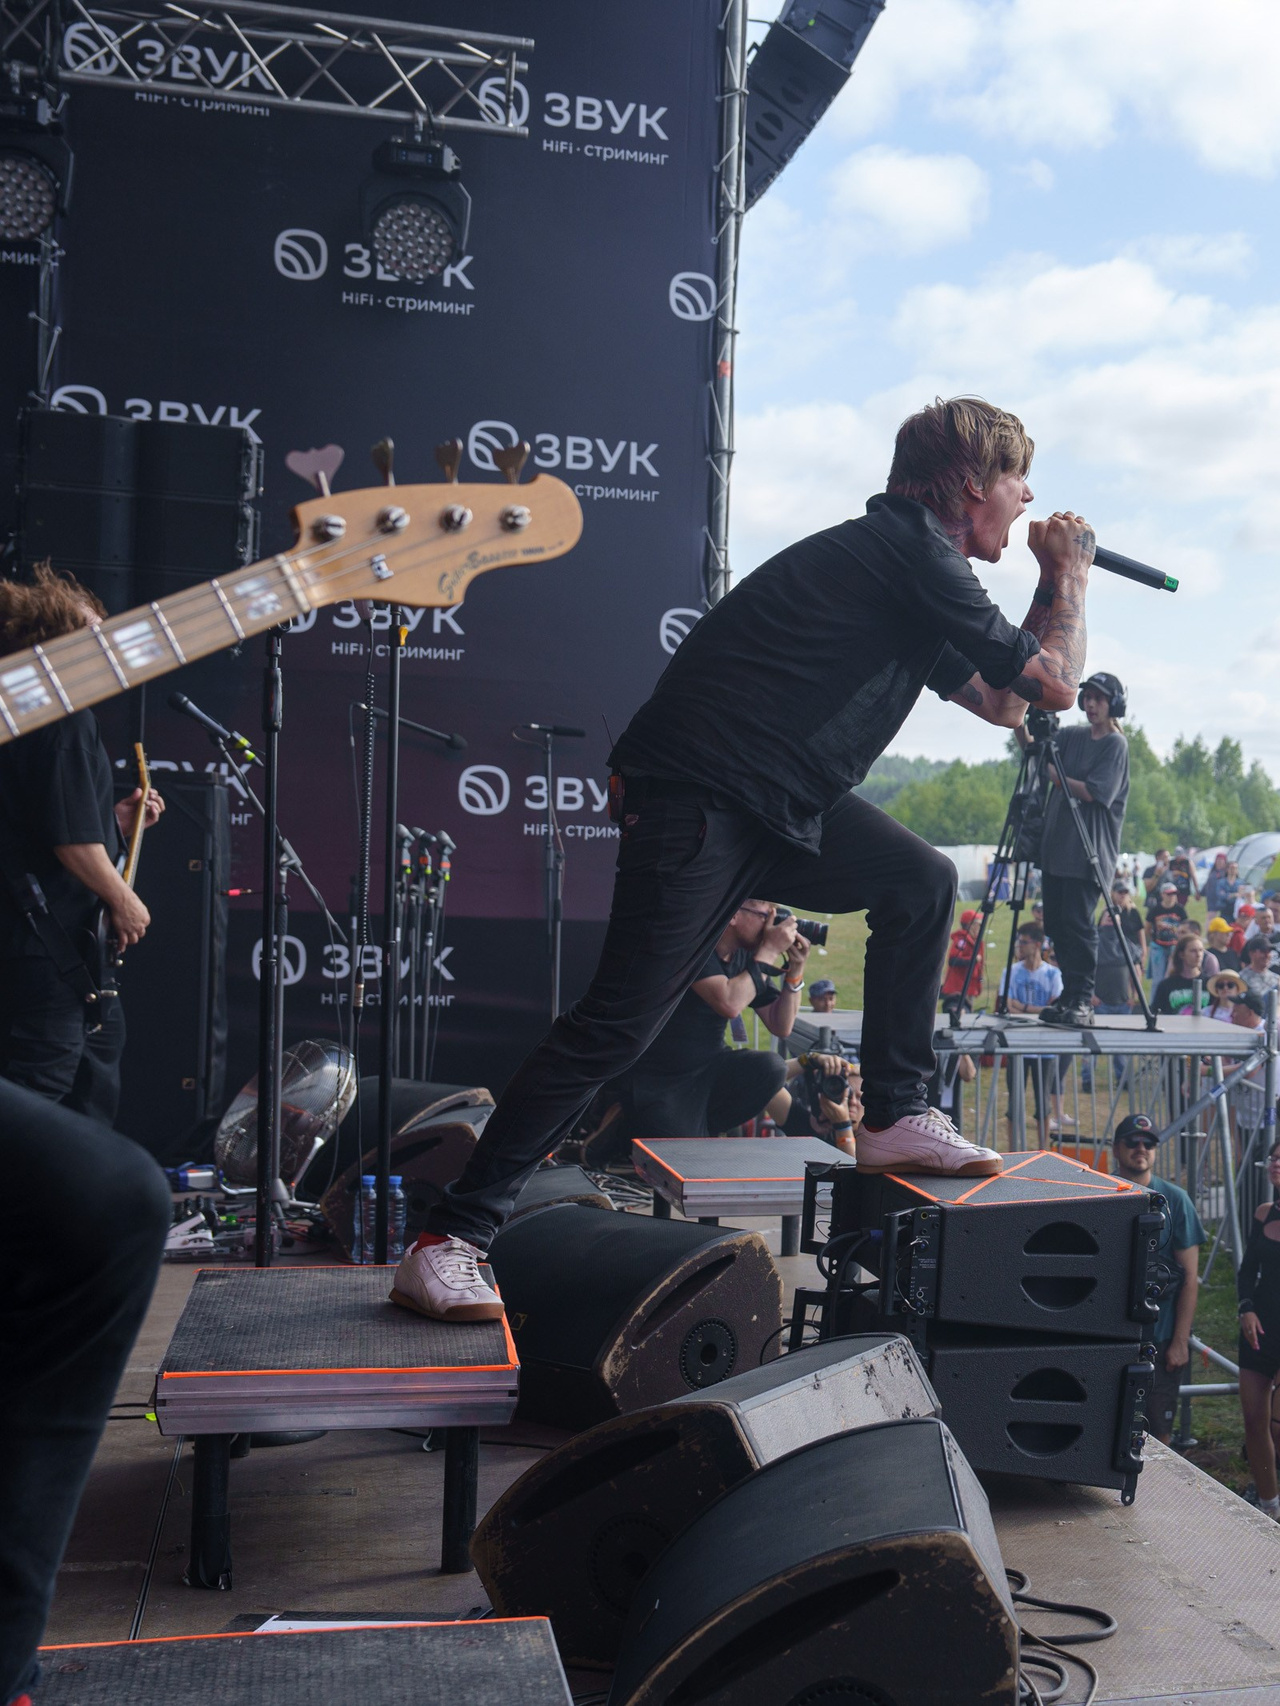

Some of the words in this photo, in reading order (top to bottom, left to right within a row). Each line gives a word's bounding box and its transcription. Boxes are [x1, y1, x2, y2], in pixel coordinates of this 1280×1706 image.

[543, 92, 669, 141] ЗВУК
[542, 139, 573, 154] HiFi
[584, 144, 669, 165] стриминг
[343, 243, 475, 290] ЗК
[342, 291, 374, 306] HiFi
[385, 296, 475, 315] стриминг
[534, 433, 660, 477] ЗВУК
[574, 484, 660, 502] стриминг
[331, 642, 364, 656] HiFi
[524, 775, 609, 812] ЗВУ
